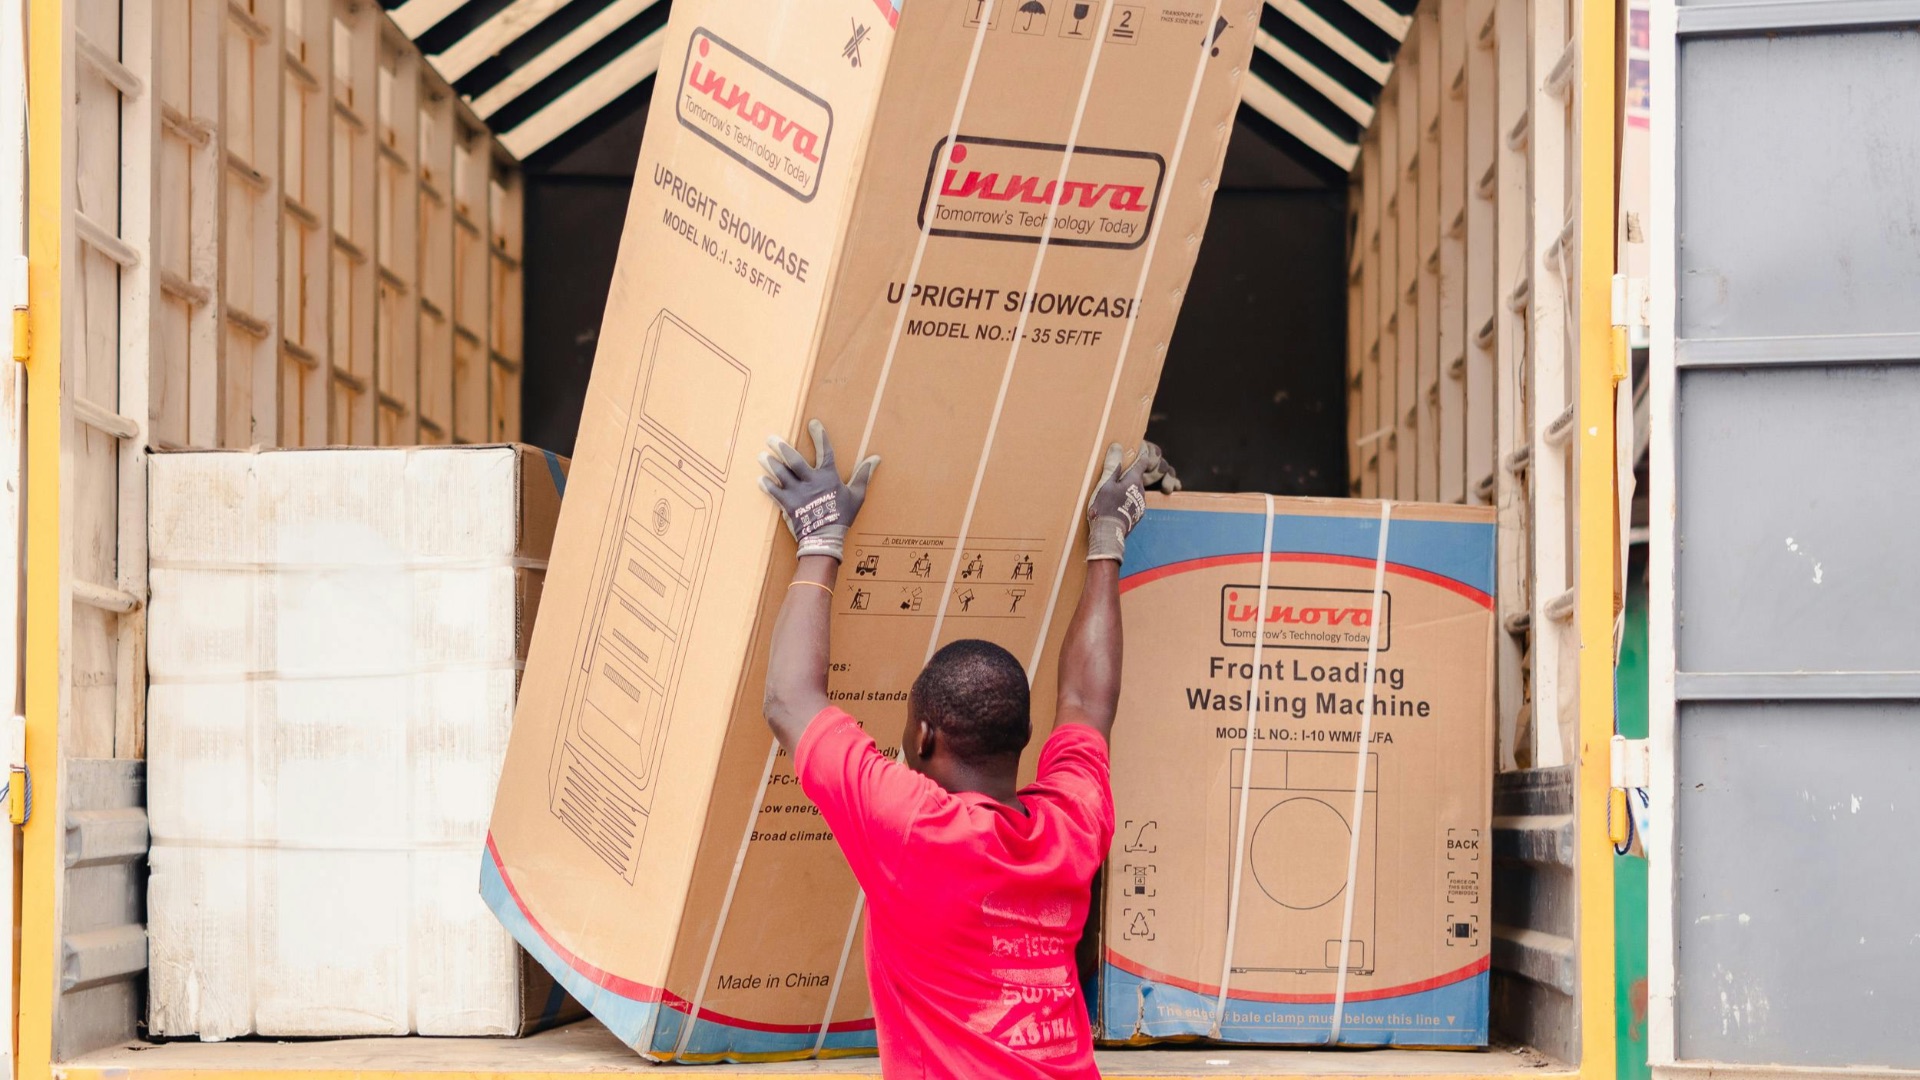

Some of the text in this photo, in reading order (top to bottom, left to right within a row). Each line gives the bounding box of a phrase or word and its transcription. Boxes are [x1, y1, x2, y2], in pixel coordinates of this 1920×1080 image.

[1120, 10, 1133, 28] 2
[1162, 9, 1194, 18] TRANSPORT
[688, 38, 820, 164] innova
[685, 94, 811, 188] Tomorrow's Technology Today
[940, 144, 1149, 212] innova
[653, 163, 810, 283] UPRIGHT SHOWCASE
[935, 205, 1014, 225] Tomorrow's
[1099, 217, 1138, 238] Today
[662, 208, 699, 246] MODEL
[734, 257, 747, 277] 35
[749, 267, 781, 298] SF/TF
[887, 282, 999, 311] UPRIGHT
[907, 320, 970, 338] MODEL
[1031, 327, 1051, 344] 35
[1055, 329, 1102, 346] SF/TF
[1289, 630, 1342, 644] Technology
[1344, 633, 1370, 644] Today
[1210, 656, 1405, 690] Front Loading
[1269, 728, 1297, 741] NO.:
[1301, 730, 1324, 742] I-10
[785, 804, 822, 815] energ
[750, 831, 833, 841] Broad climate
[1447, 840, 1479, 849] BACK
[717, 972, 830, 990] Made in China
[1157, 1005, 1183, 1017] The
[1184, 1008, 1215, 1021] edge
[1232, 1011, 1260, 1023] bale
[1264, 1012, 1305, 1025] clamp
[1308, 1015, 1335, 1024] mus
[1345, 1013, 1384, 1024] below
[1387, 1014, 1412, 1025] this
[1416, 1014, 1440, 1025] line
